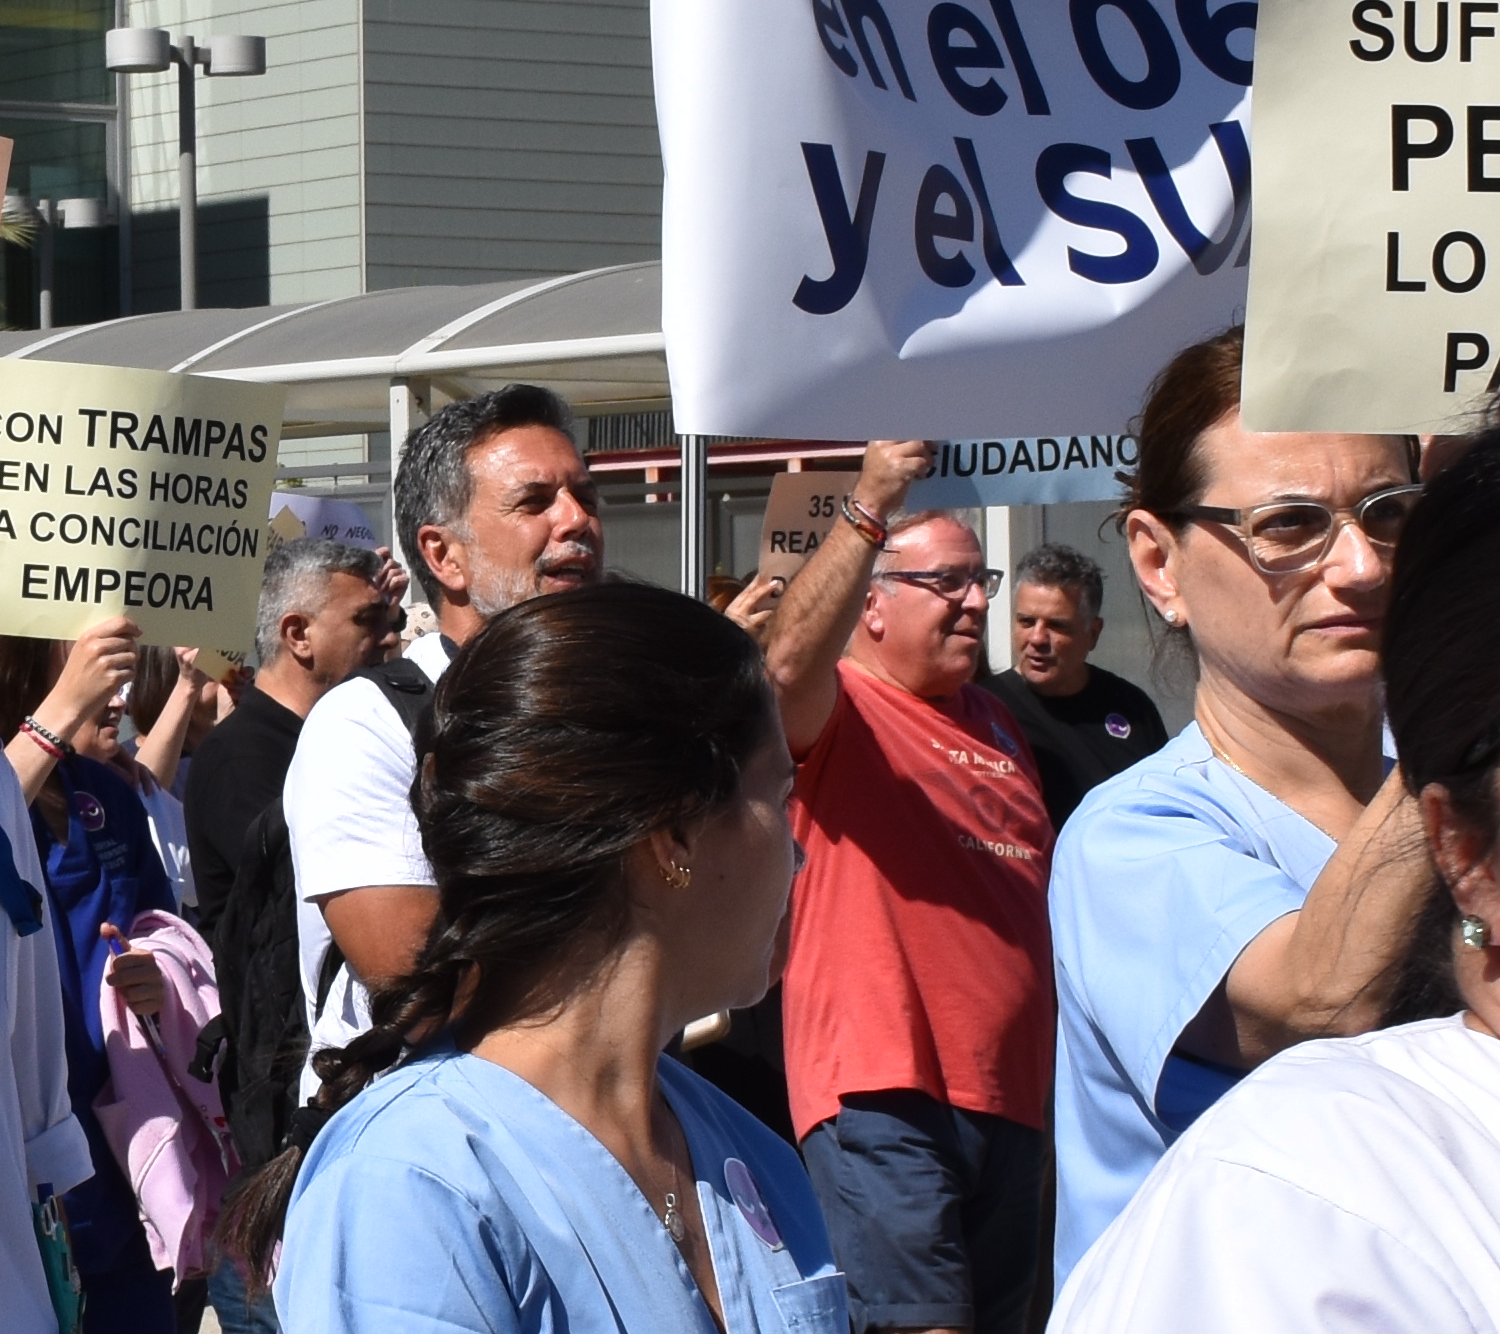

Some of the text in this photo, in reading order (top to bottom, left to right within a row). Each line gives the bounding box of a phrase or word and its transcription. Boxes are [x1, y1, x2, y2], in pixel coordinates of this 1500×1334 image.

[791, 119, 1252, 316] y el SU
[1385, 229, 1487, 295] LO
[76, 408, 269, 463] TRAMPAS
[62, 460, 138, 501] LAS
[147, 469, 248, 510] HORAS
[808, 494, 835, 519] 35
[28, 508, 260, 559] CONCILIACIÓN
[20, 563, 215, 613] EMPEORA
